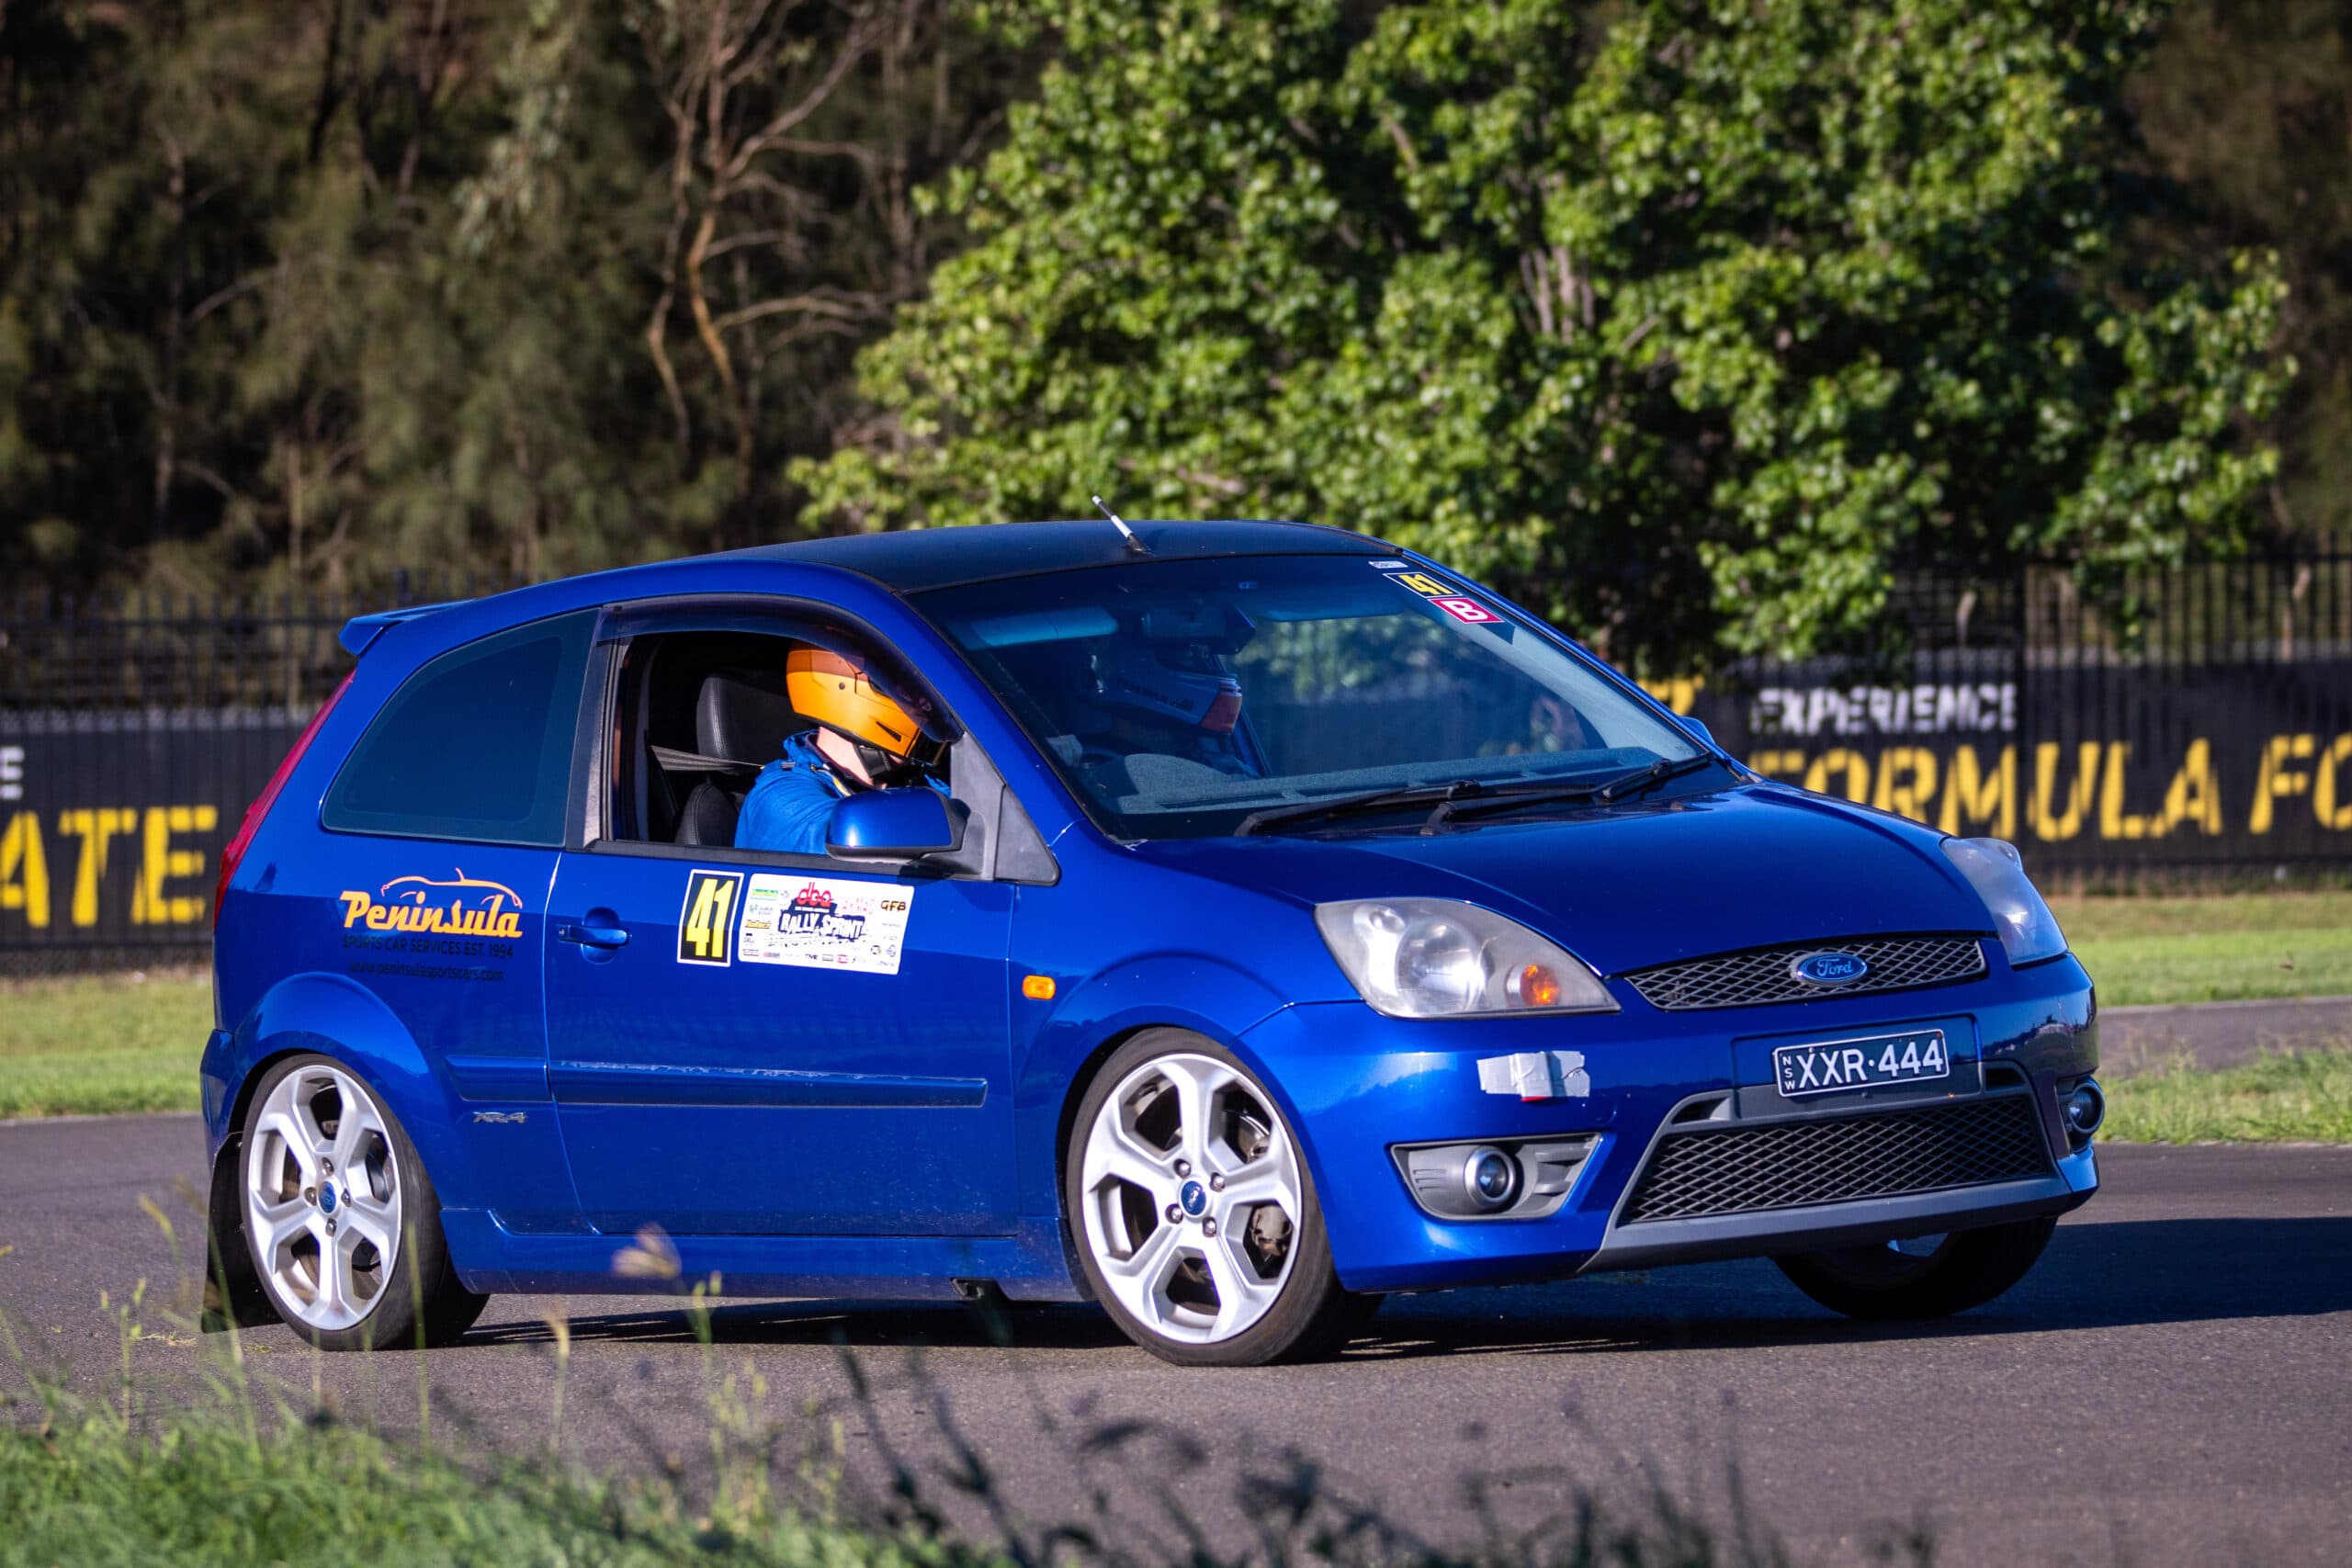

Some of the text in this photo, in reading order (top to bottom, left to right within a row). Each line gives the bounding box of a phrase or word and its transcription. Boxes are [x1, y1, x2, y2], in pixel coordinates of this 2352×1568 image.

[1398, 573, 1453, 595] 41
[1440, 601, 1488, 621] B
[339, 889, 523, 938] Peninsula
[880, 899, 906, 912] GFB
[685, 878, 735, 958] 41
[343, 934, 382, 950] SPORTS
[384, 939, 407, 952] CAR
[410, 940, 461, 956] SERVICES
[1816, 958, 1853, 976] Ford
